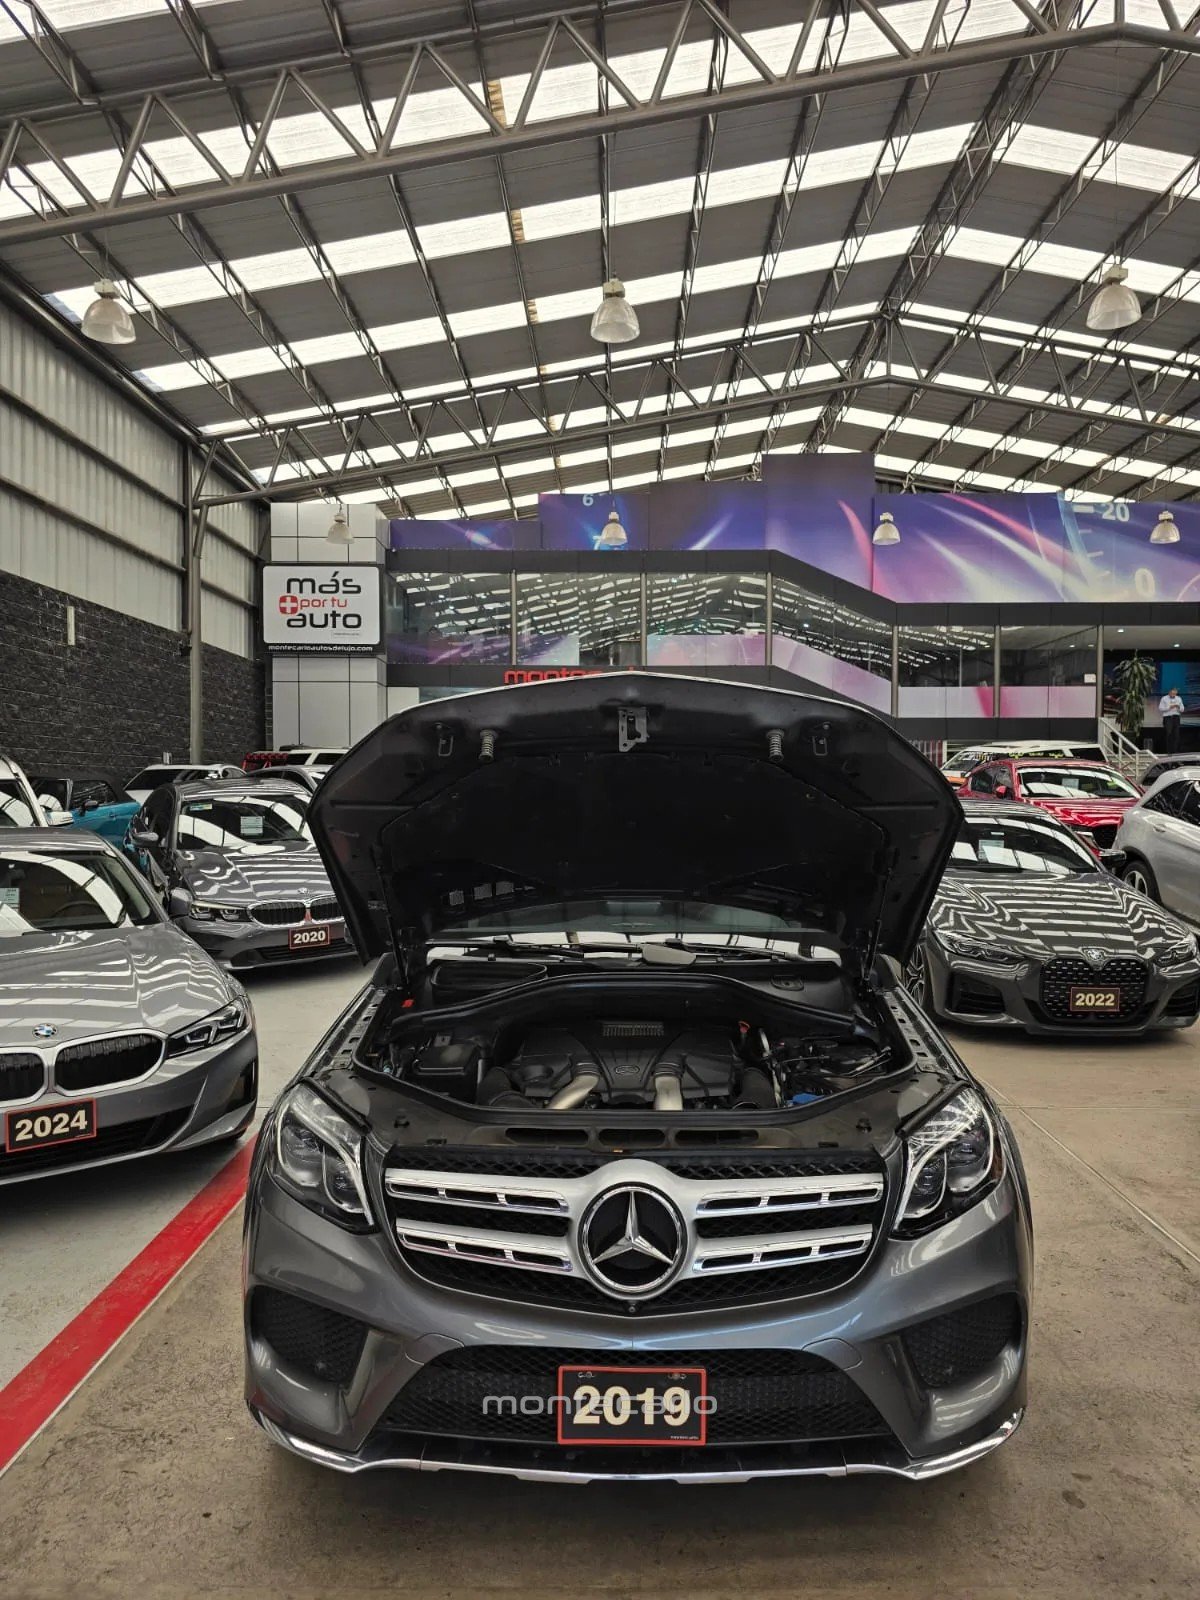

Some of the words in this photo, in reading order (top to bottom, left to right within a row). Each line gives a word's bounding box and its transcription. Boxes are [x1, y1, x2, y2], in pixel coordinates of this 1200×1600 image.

[1101, 502, 1130, 522] 20
[286, 570, 362, 594] más
[1134, 567, 1156, 597] 0
[300, 598, 328, 610] por
[331, 597, 349, 608] tu
[286, 610, 362, 629] auto
[293, 930, 326, 944] 2020
[1075, 993, 1115, 1006] 2022
[15, 1109, 88, 1142] 2024
[572, 1384, 692, 1427] 2019
